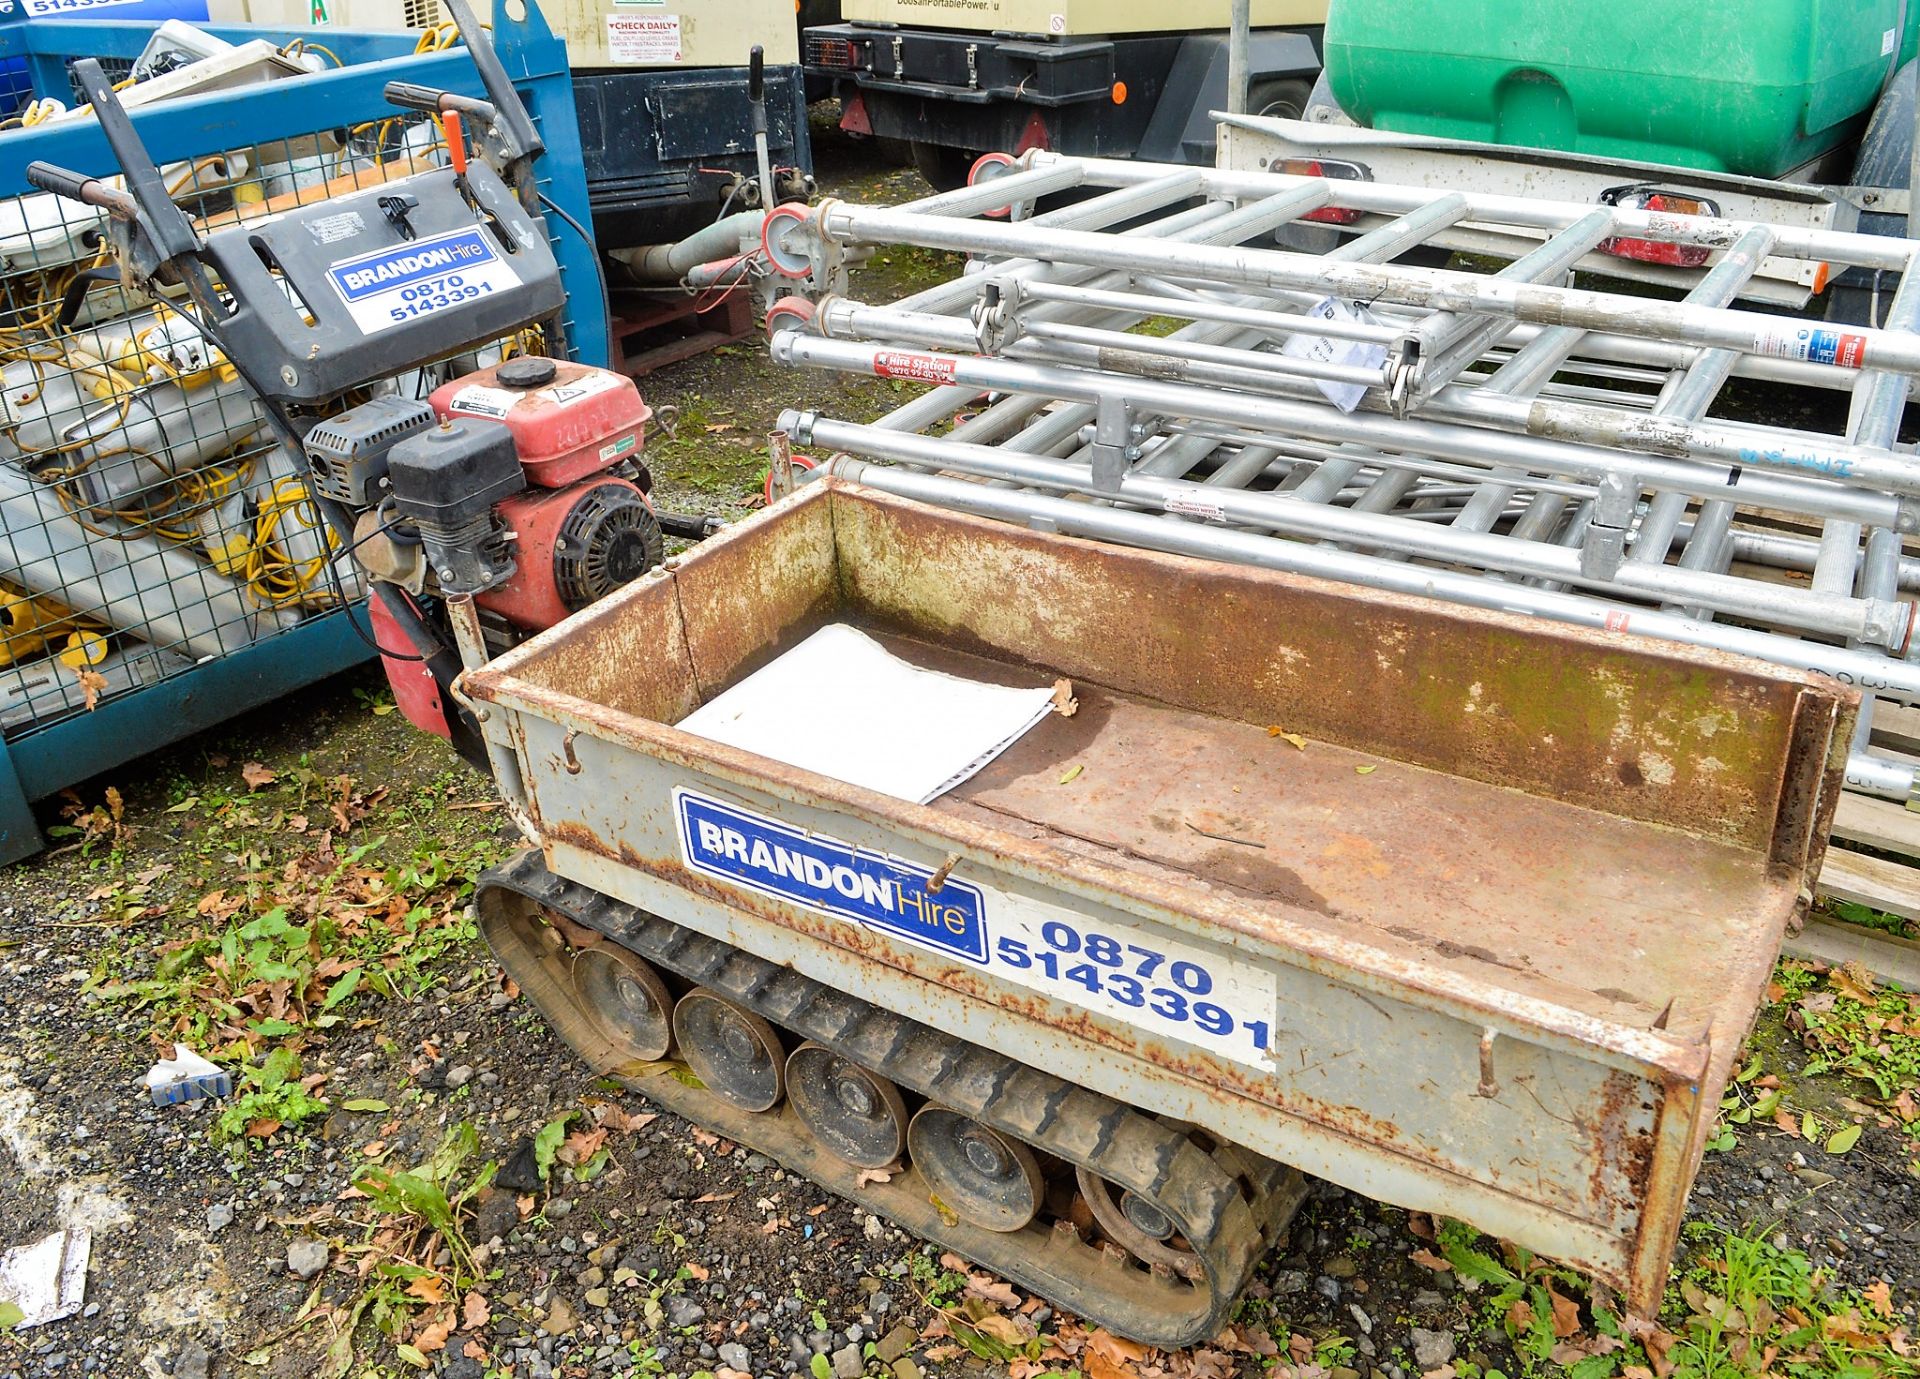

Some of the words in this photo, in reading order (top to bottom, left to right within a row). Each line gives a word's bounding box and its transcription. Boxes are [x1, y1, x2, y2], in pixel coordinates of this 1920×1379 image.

[615, 22, 645, 30] CHECK
[647, 22, 672, 30] DAILY
[390, 281, 493, 321] 5143391
[400, 275, 464, 302] 0870
[889, 355, 910, 367] Hire
[912, 358, 951, 372] Station
[1041, 921, 1213, 995] 0870
[997, 936, 1269, 1050] 5143391
